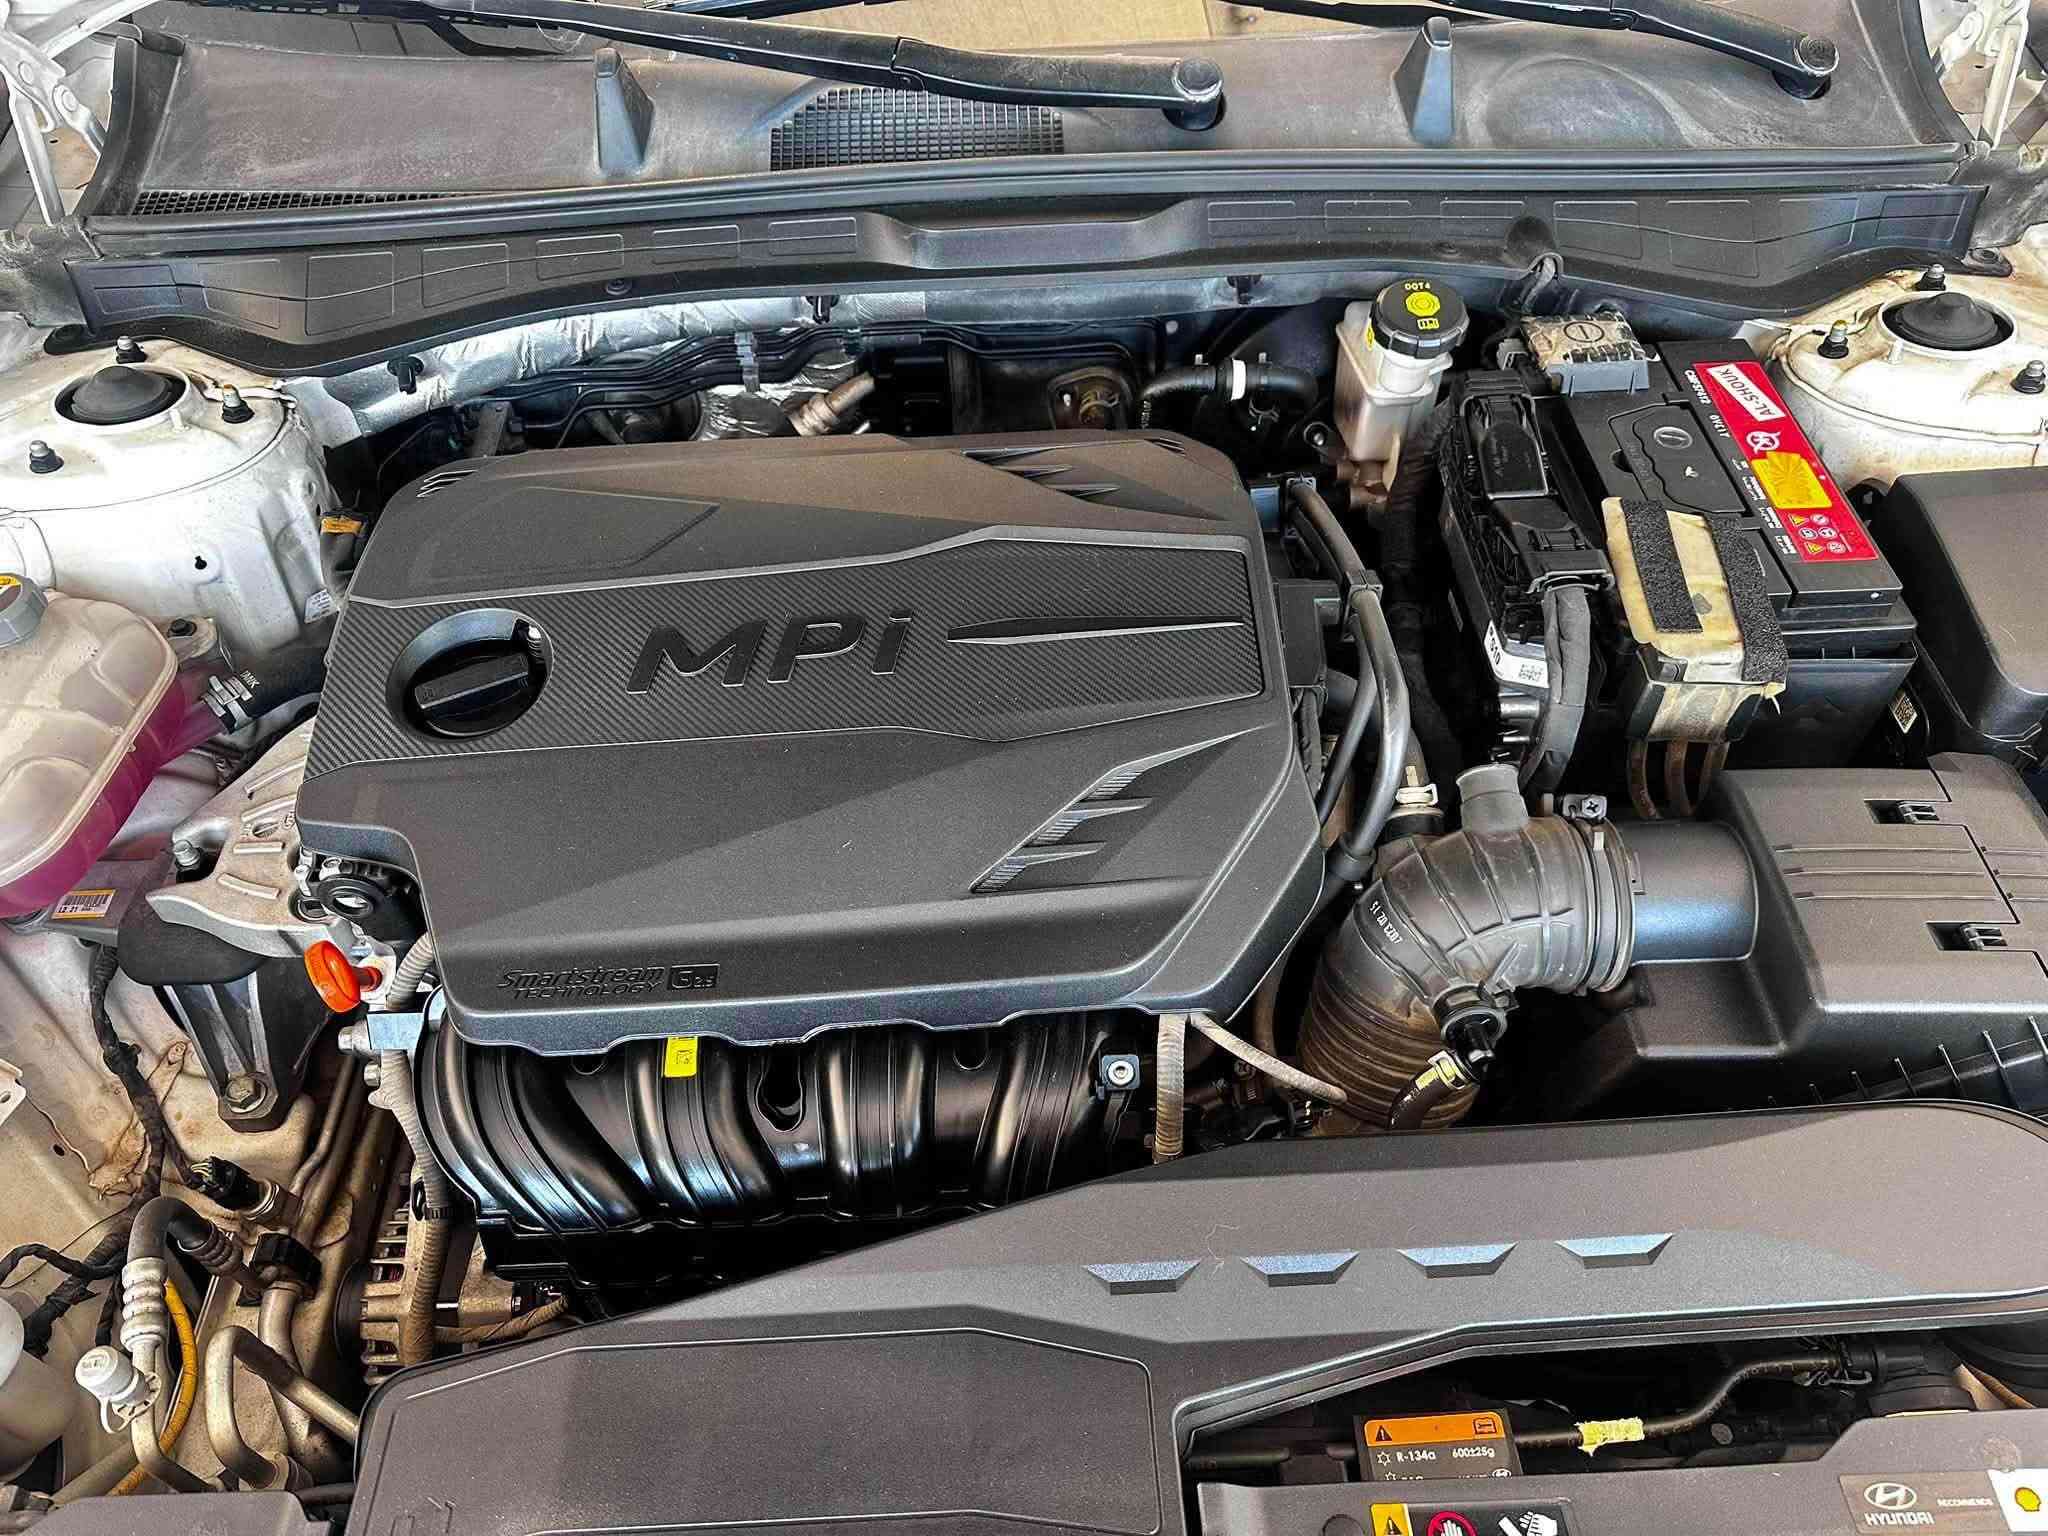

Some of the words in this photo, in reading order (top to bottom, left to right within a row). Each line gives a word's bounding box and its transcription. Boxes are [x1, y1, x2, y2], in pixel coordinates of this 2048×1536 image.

[1719, 368, 1776, 416] AL-SHOUK
[625, 609, 914, 695] MPi
[498, 965, 666, 990] Smartstream
[512, 980, 664, 999] TECHNOLOGY
[1395, 1450, 1437, 1463] R-134a
[1451, 1446, 1496, 1460] 600±25g
[1864, 1511, 1936, 1526] HYUNDAI
